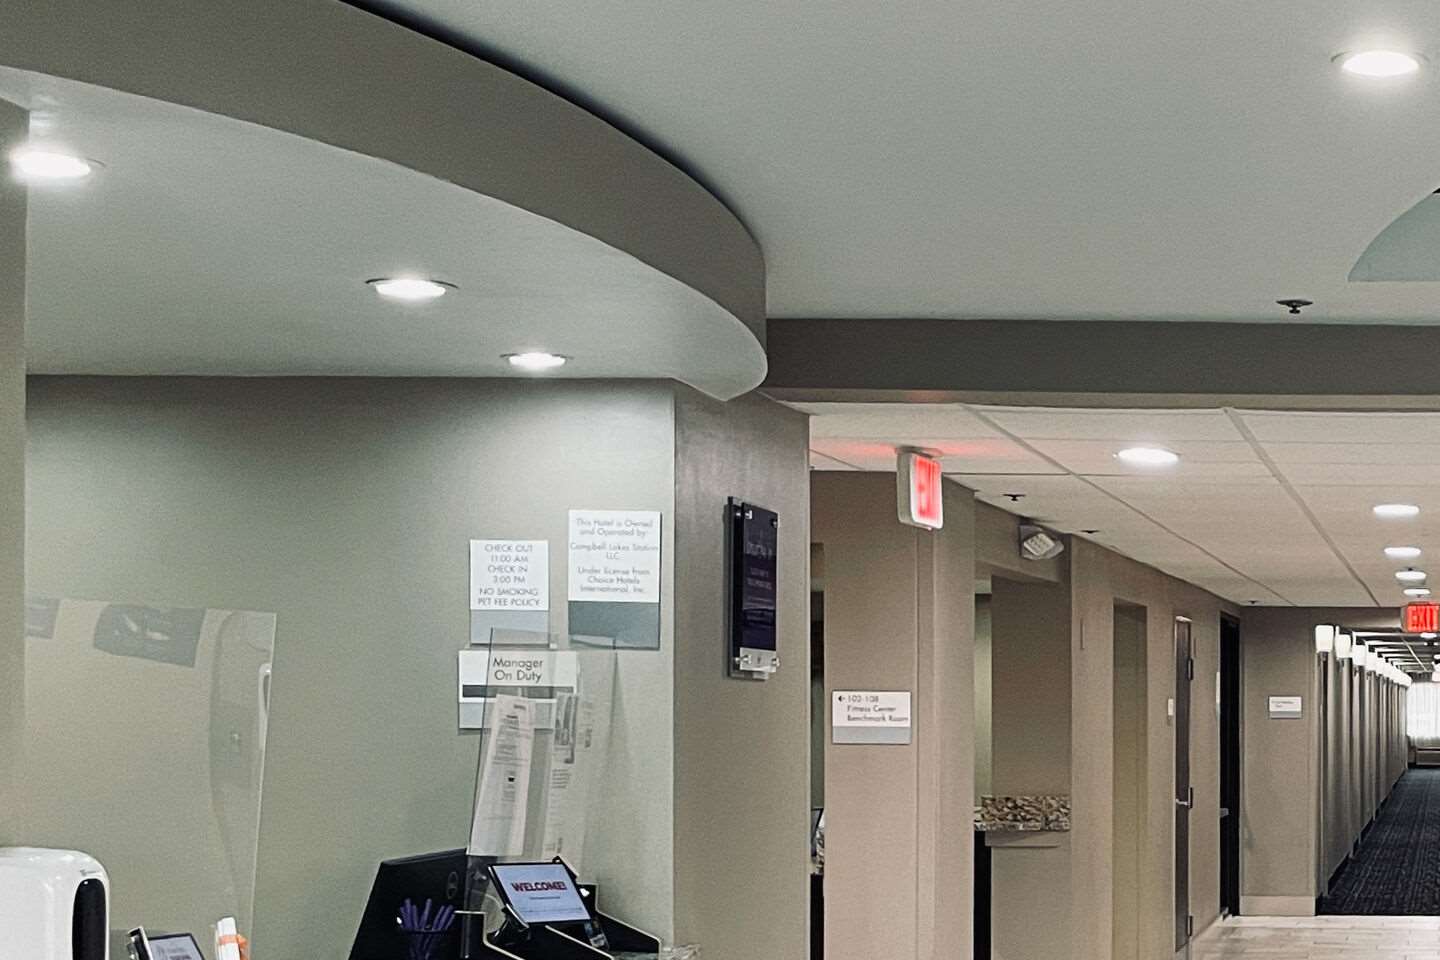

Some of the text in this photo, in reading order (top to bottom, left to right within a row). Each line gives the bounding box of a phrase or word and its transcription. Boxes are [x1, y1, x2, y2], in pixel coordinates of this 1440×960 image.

[484, 544, 533, 553] CHECK OUT
[514, 555, 528, 563] AM
[487, 564, 515, 574] CHECK
[513, 575, 526, 584] PM
[479, 587, 495, 596] NO
[1408, 606, 1440, 631] EXIT
[492, 658, 545, 672] Manager
[494, 670, 543, 684] On Duty
